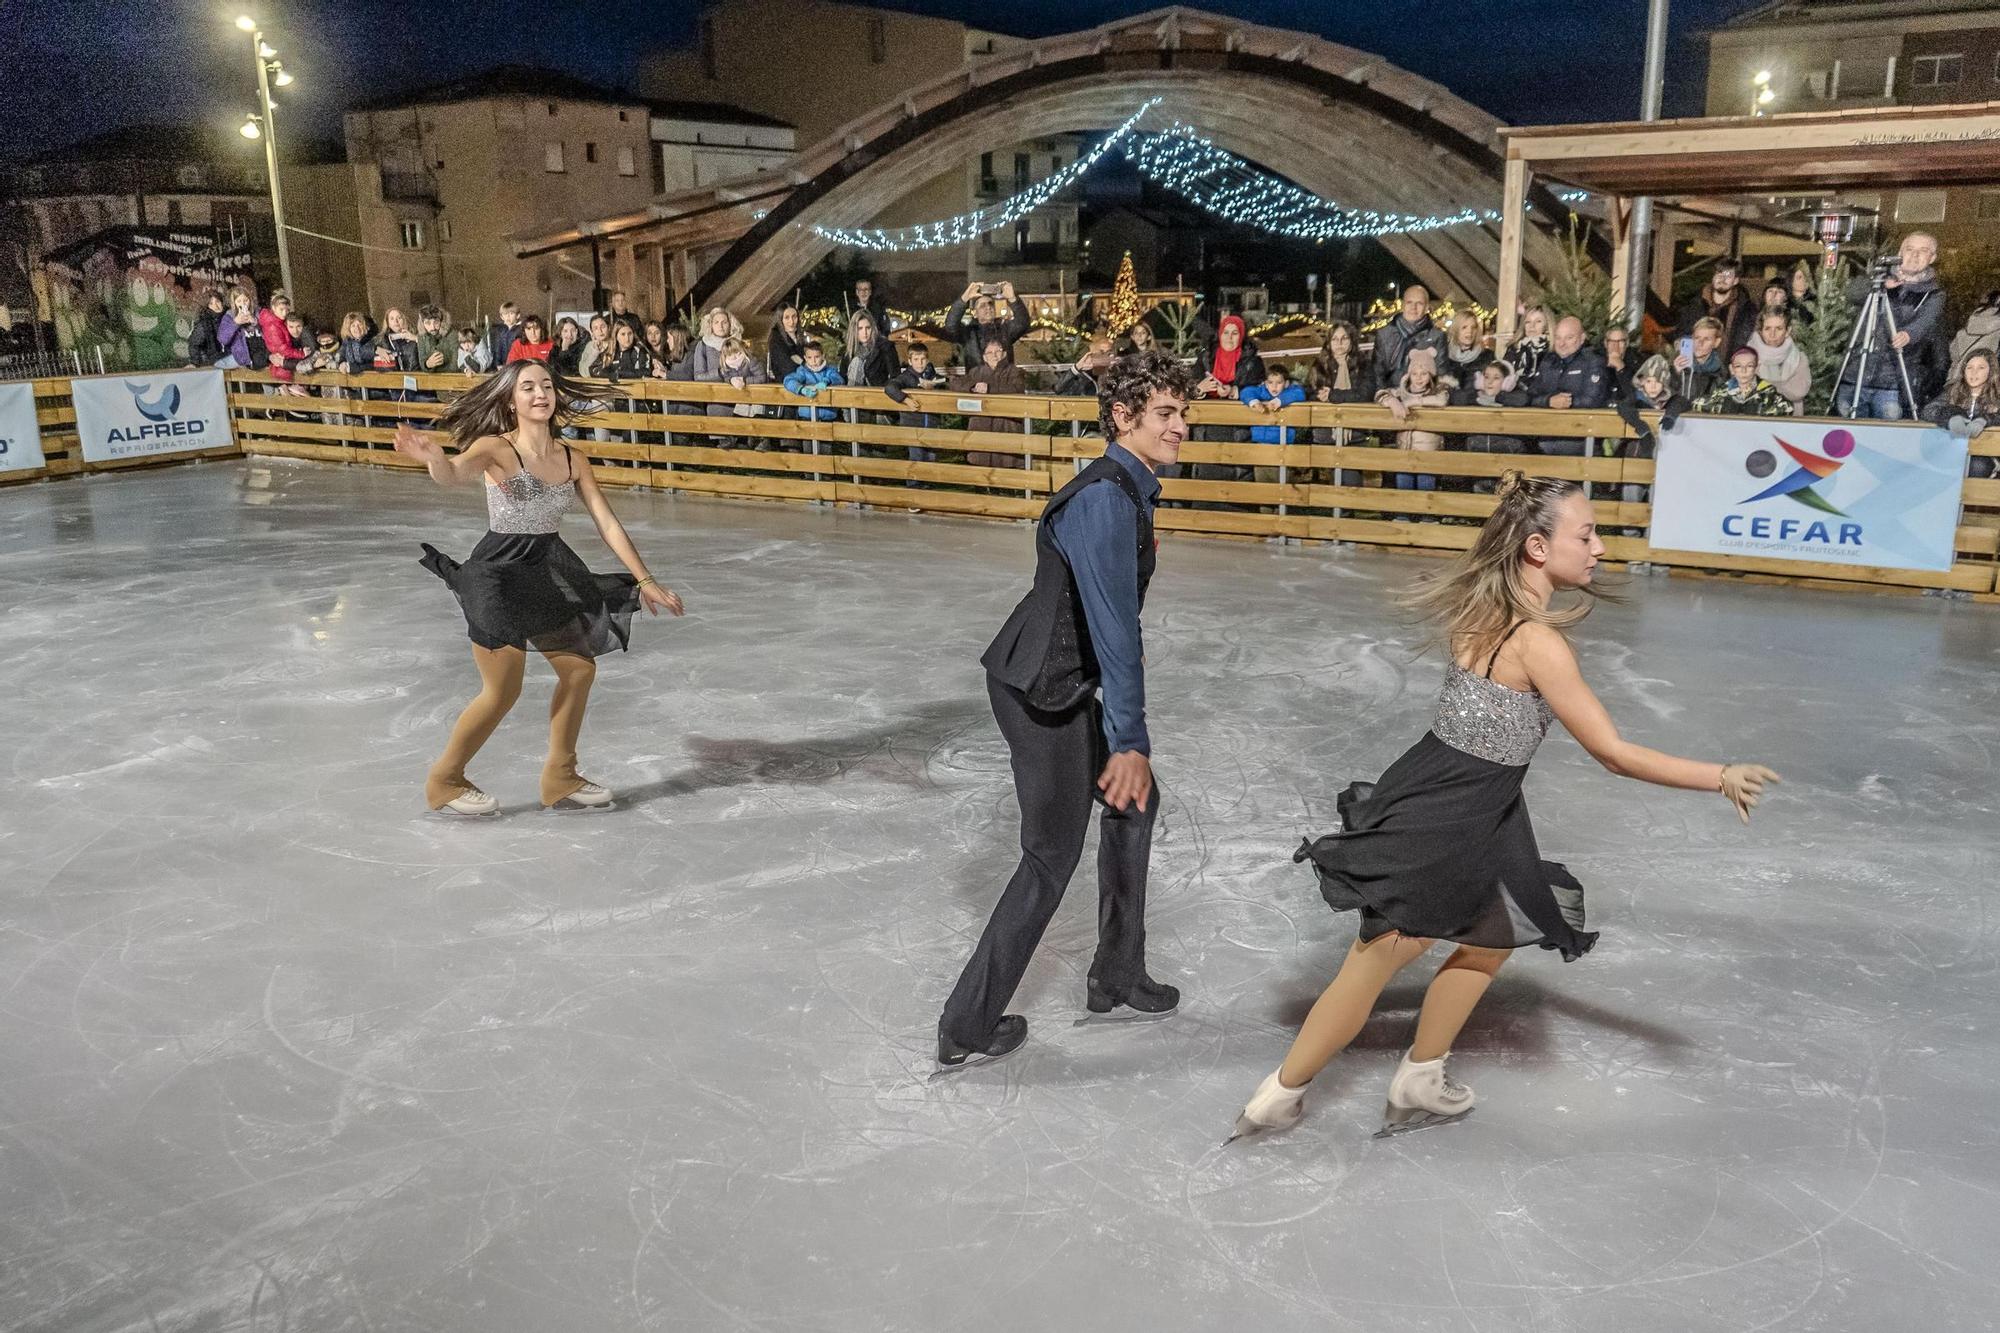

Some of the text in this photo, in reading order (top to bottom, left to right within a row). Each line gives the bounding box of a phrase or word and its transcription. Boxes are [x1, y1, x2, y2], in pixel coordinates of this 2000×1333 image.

[110, 438, 206, 455] REFRIGERATION
[1722, 515, 1864, 546] CEFAR
[1719, 539, 1744, 548] CLUB
